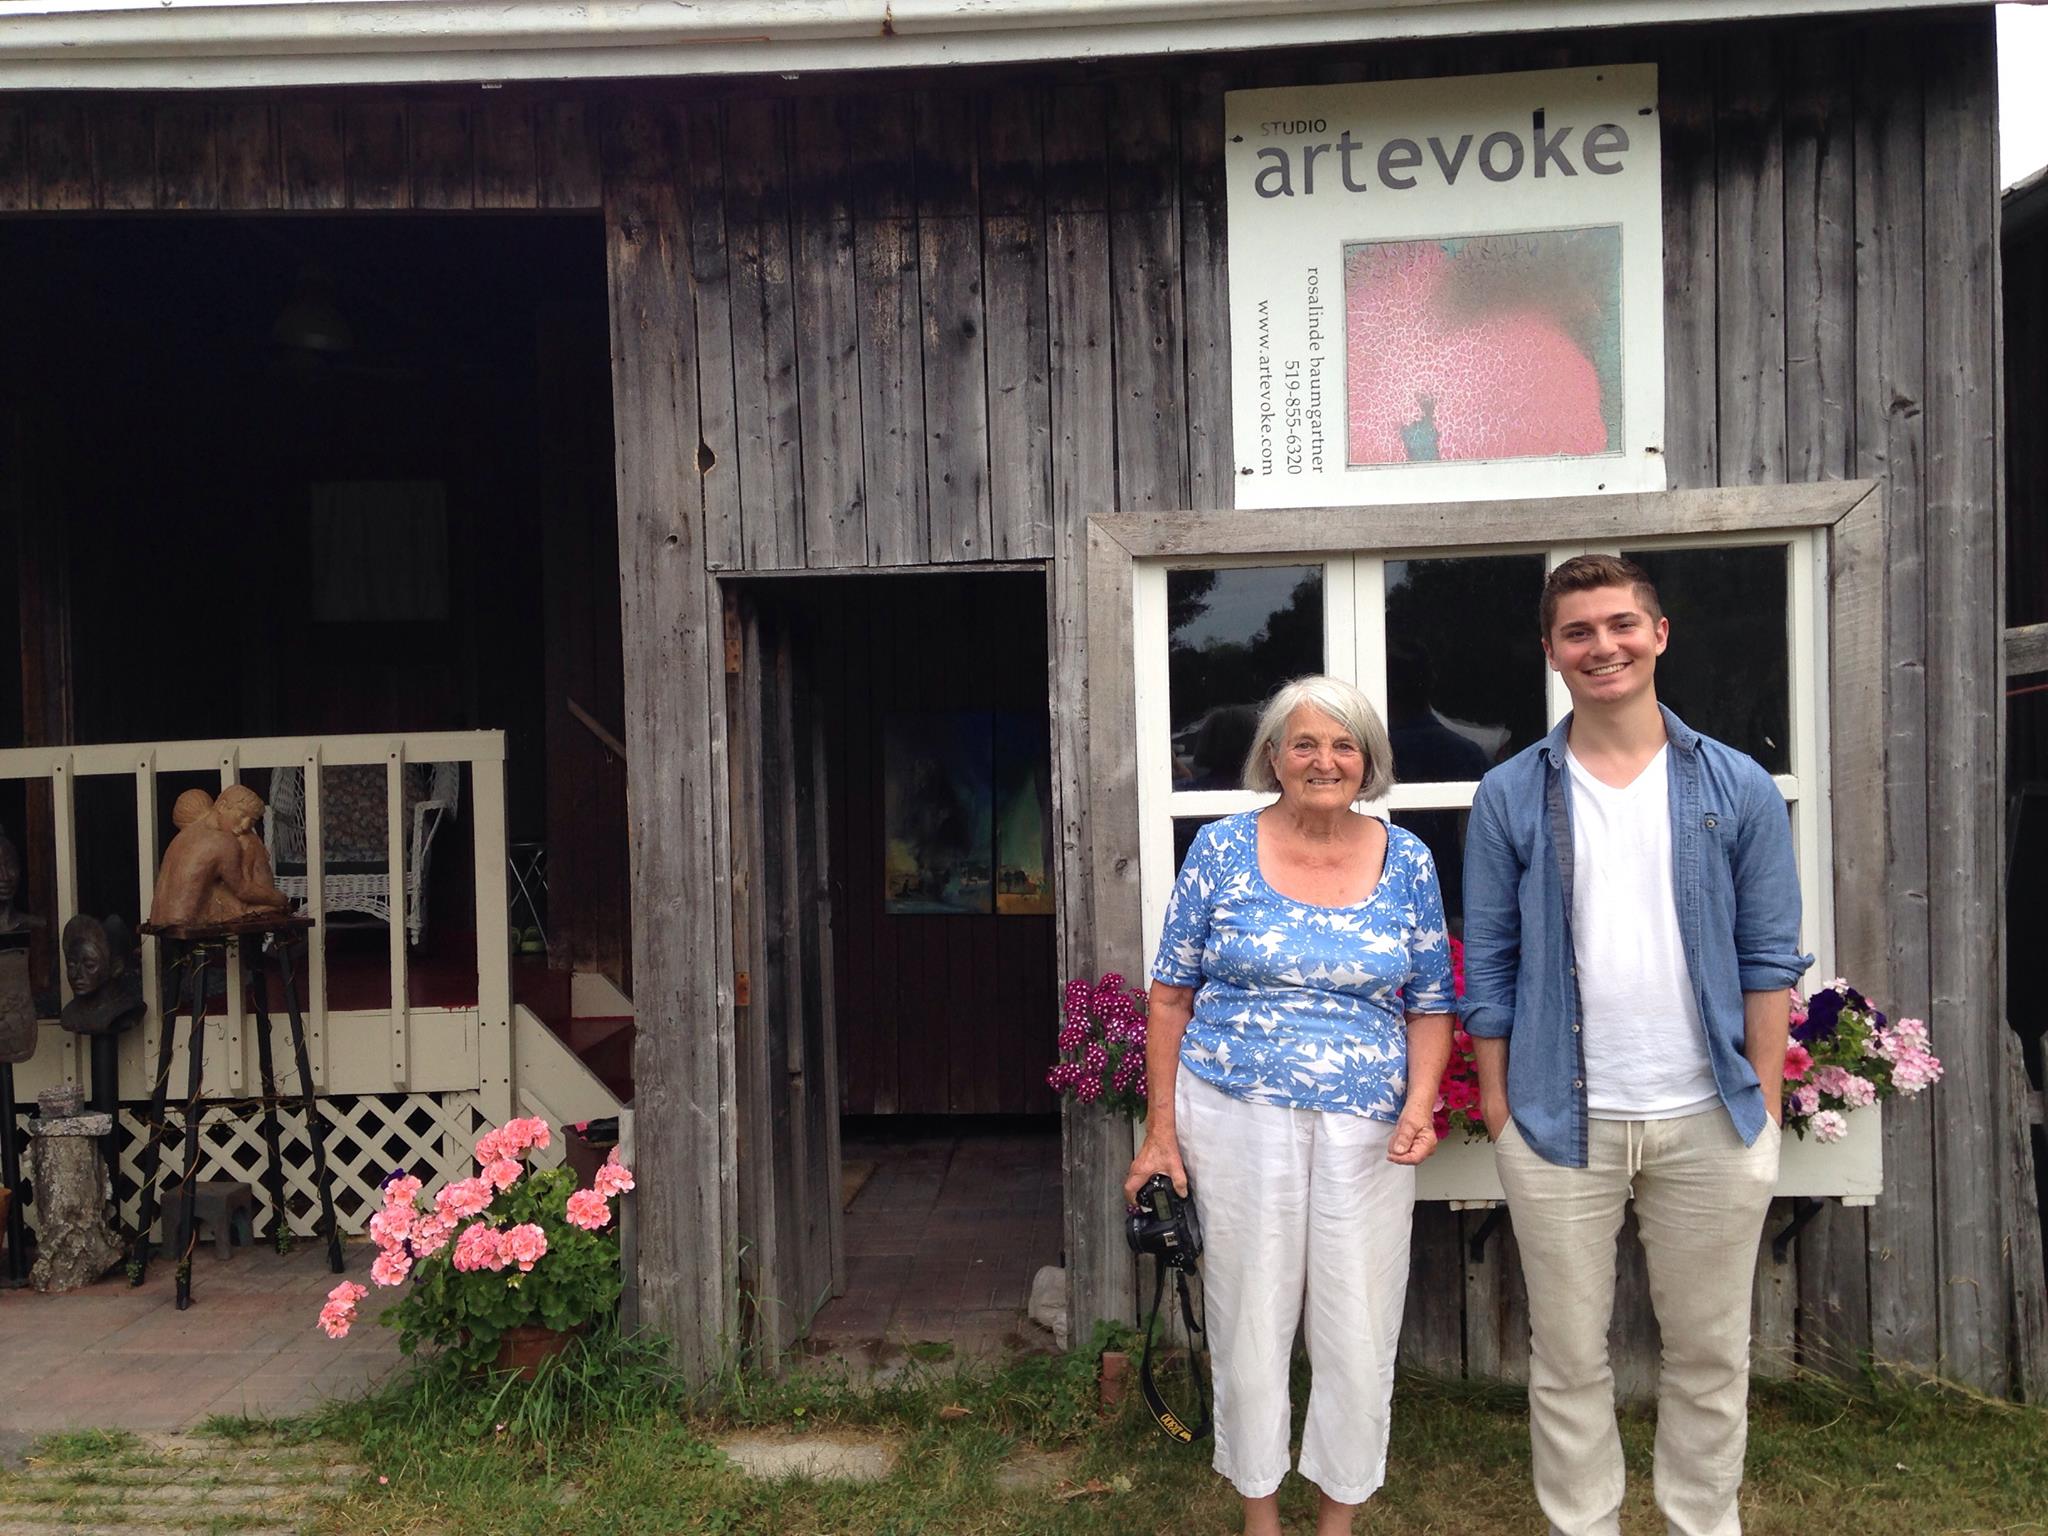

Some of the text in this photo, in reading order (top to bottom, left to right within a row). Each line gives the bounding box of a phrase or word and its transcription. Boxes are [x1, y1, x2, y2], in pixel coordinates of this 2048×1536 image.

[1254, 107, 1630, 199] artevoke
[1260, 119, 1327, 136] STUDIO
[1257, 299, 1276, 476] www.artevoke.com
[1284, 360, 1302, 475] 519-855-6320
[1305, 267, 1325, 474] rosalinde baumgartner
